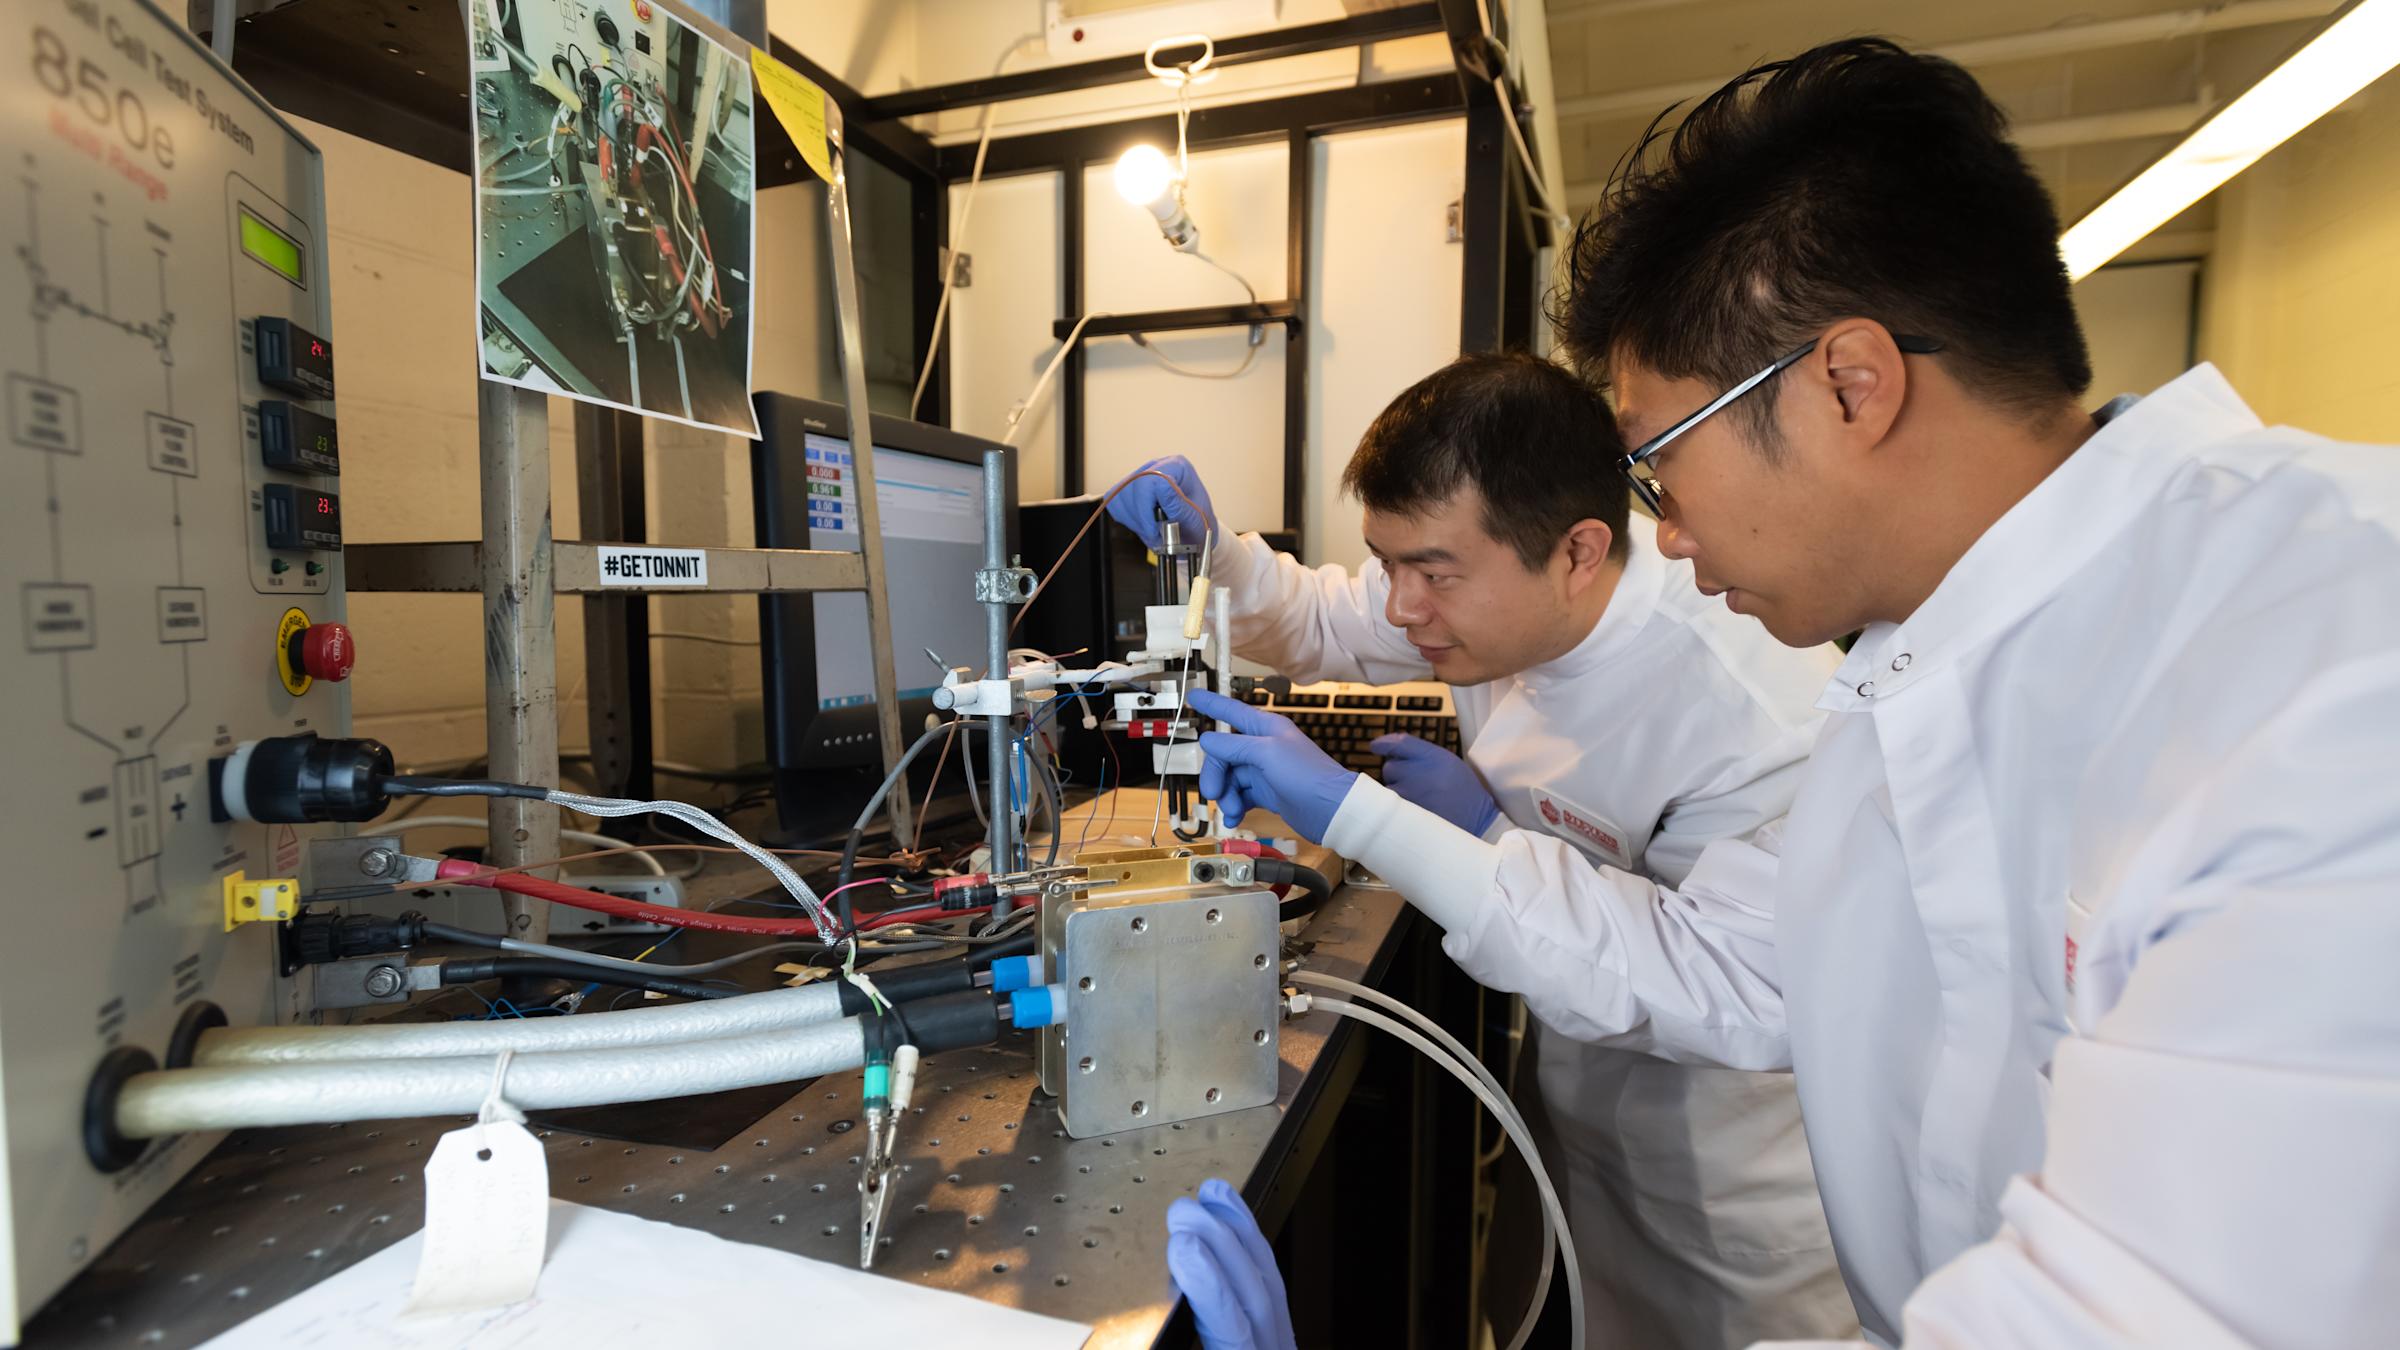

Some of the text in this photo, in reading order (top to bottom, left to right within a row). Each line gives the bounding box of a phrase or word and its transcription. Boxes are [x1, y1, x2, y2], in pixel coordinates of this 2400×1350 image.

[32, 23, 175, 171] 850e
[151, 51, 192, 106] Test
[195, 87, 254, 156] System
[311, 340, 323, 357] 24
[317, 498, 329, 514] 23
[604, 555, 700, 578] #GETONNIT
[638, 911, 658, 921] Cable
[663, 916, 686, 926] Power
[690, 920, 712, 929] Gauge
